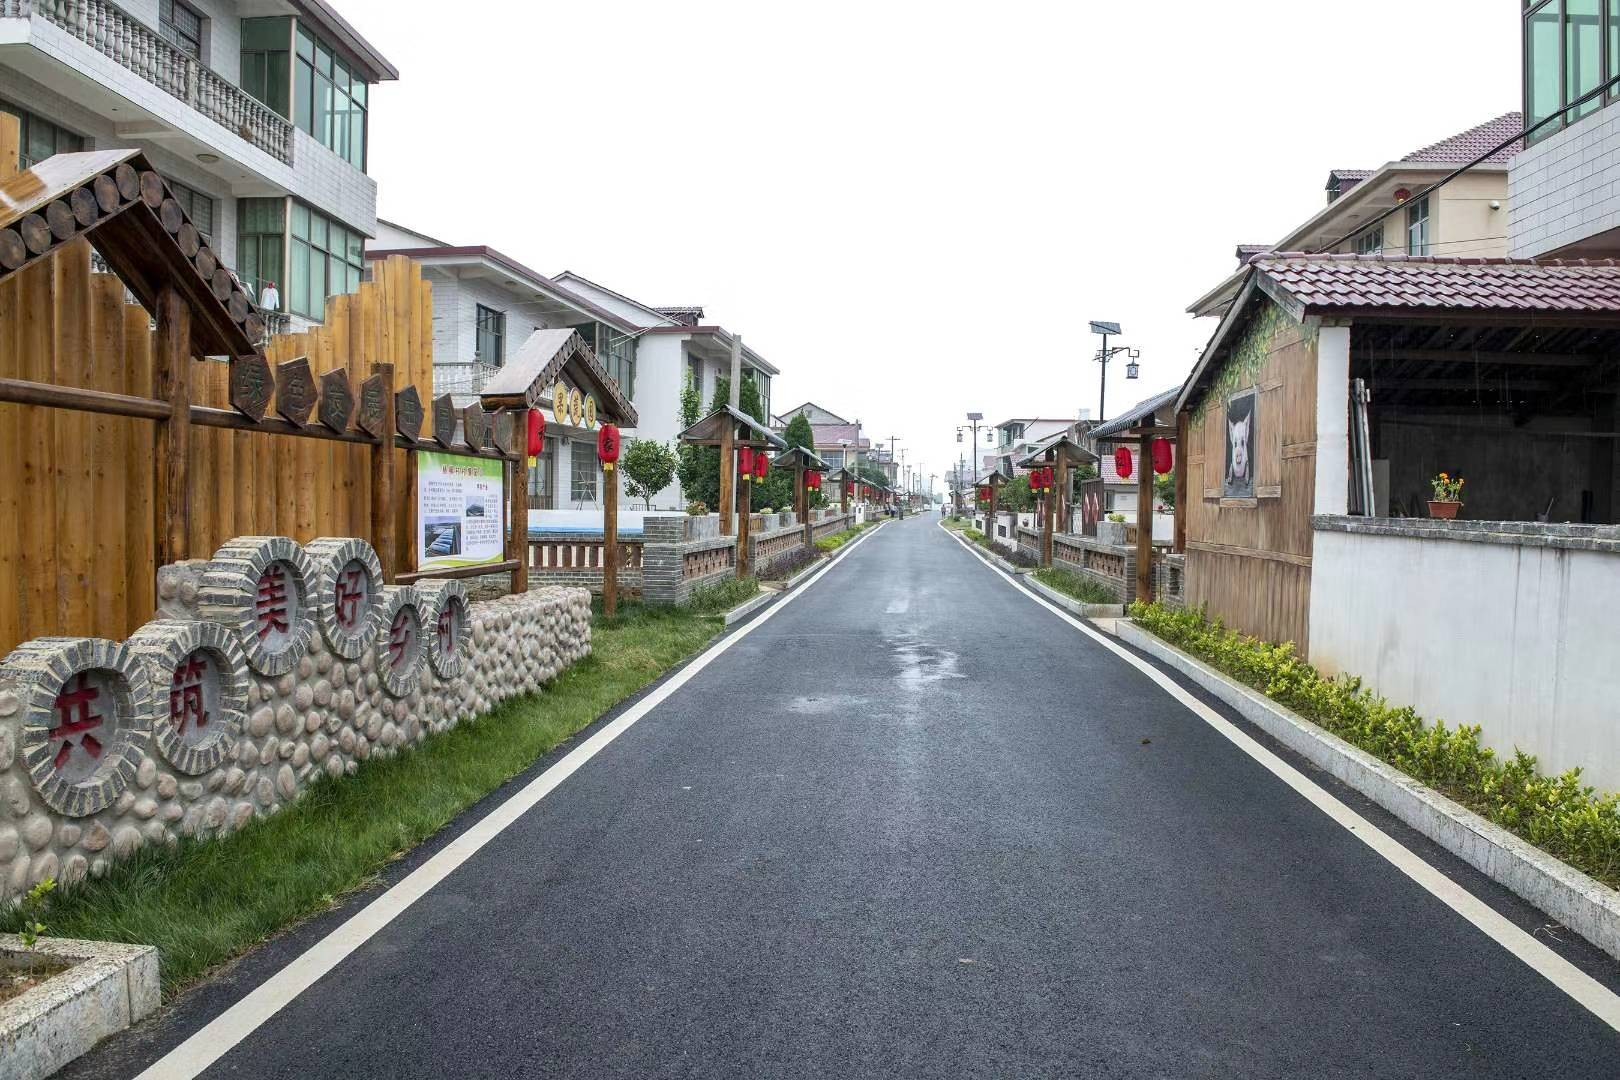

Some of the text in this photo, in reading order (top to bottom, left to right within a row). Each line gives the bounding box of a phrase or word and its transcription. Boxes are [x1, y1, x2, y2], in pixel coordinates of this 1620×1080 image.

[50, 566, 456, 770] 共筑美好乡村
